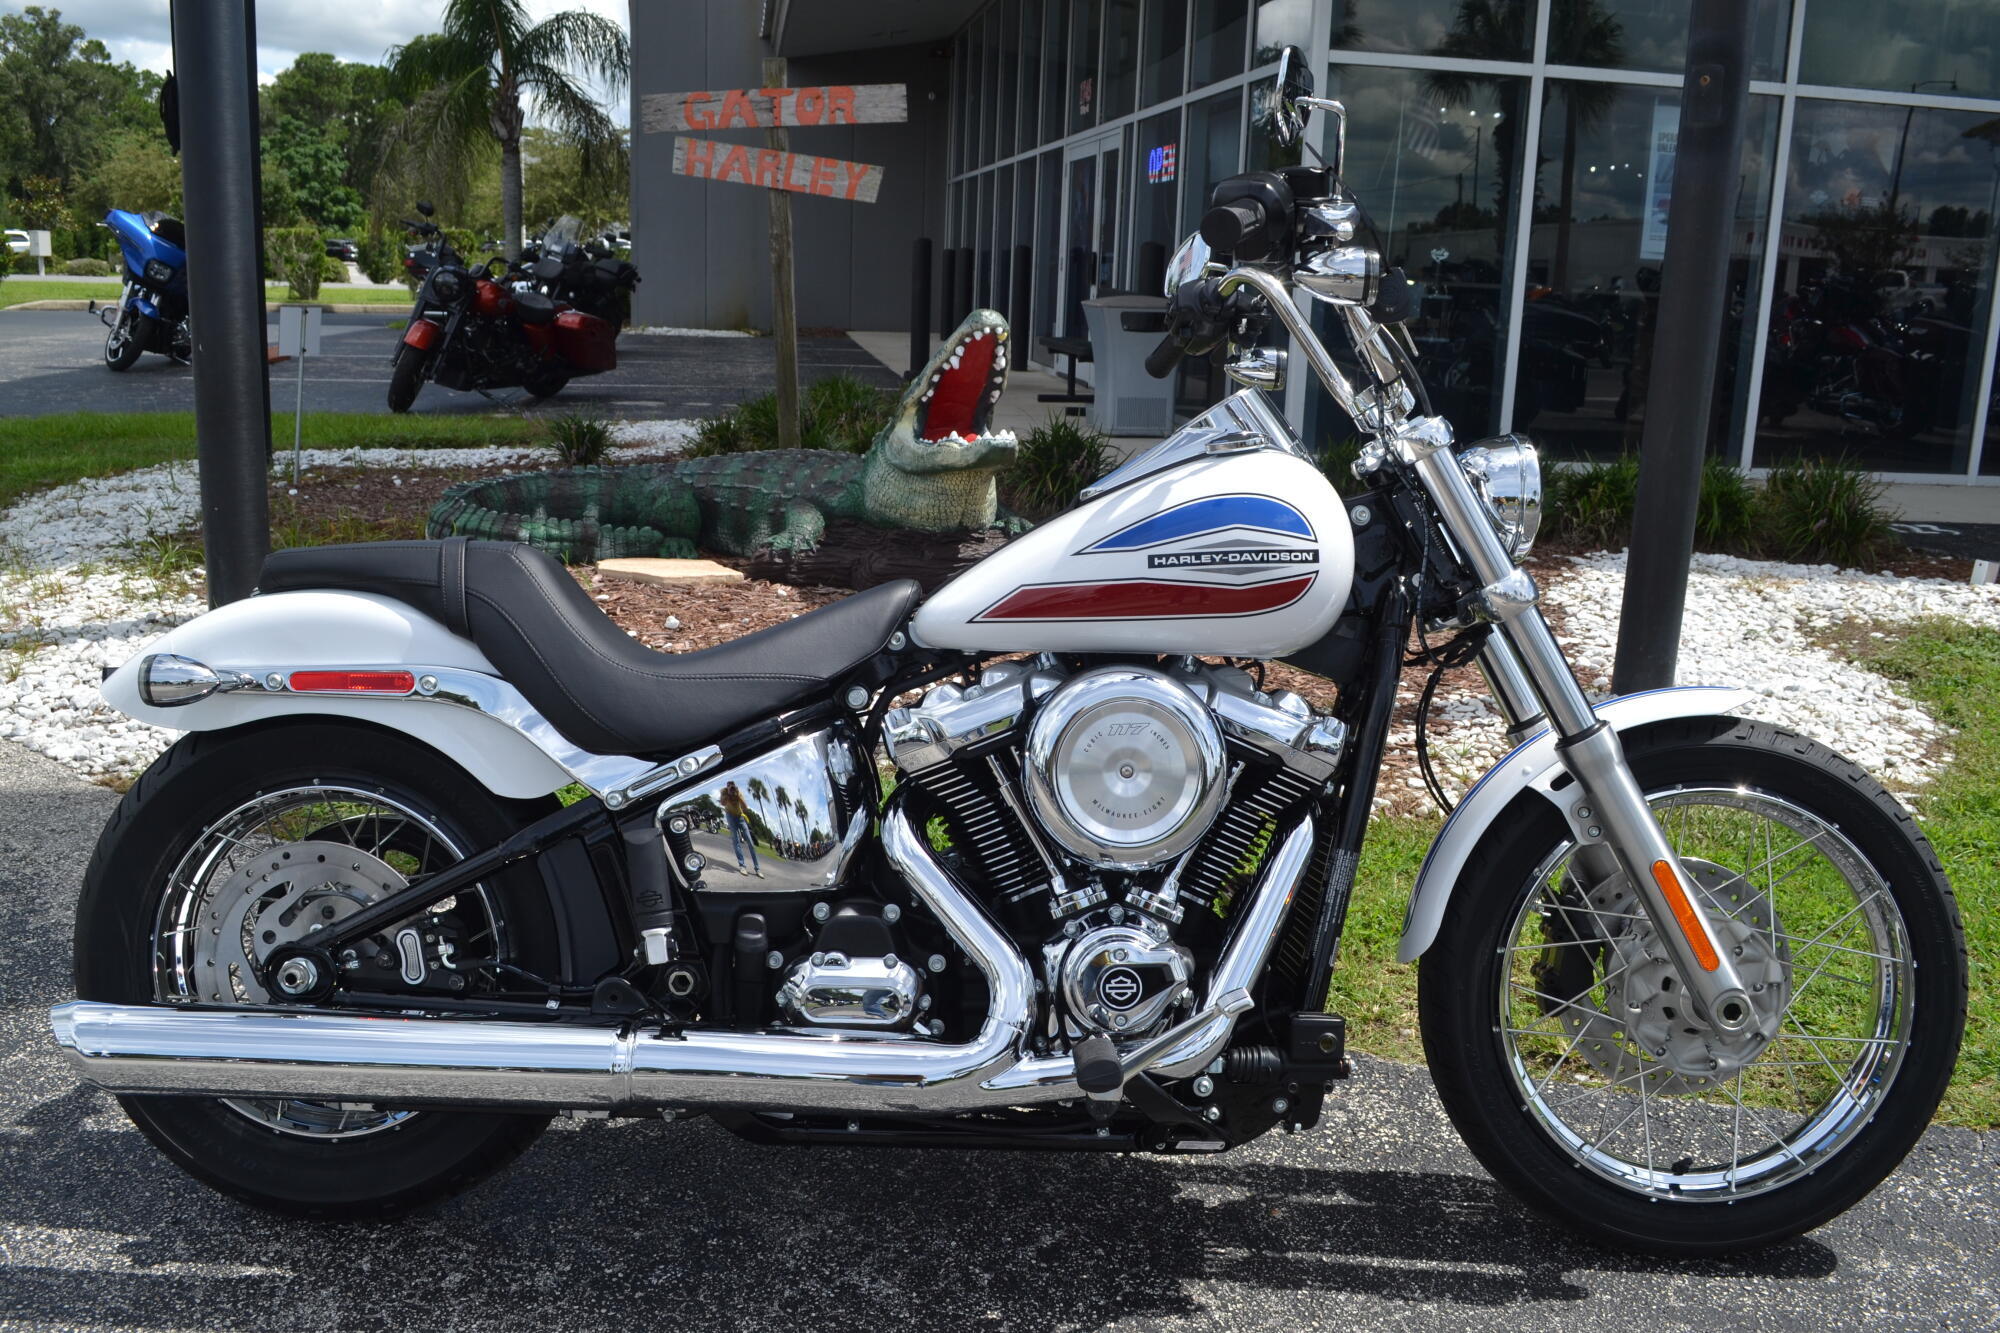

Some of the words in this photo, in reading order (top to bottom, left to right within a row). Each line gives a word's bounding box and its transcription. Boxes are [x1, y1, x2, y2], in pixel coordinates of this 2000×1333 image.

[683, 85, 858, 130] GATOR
[685, 138, 869, 200] HARLEY
[1149, 143, 1176, 184] OPEN
[1154, 552, 1315, 566] HARLEY-DAVIDSON
[1083, 731, 1103, 753] CUBIC
[1107, 722, 1151, 737] 117
